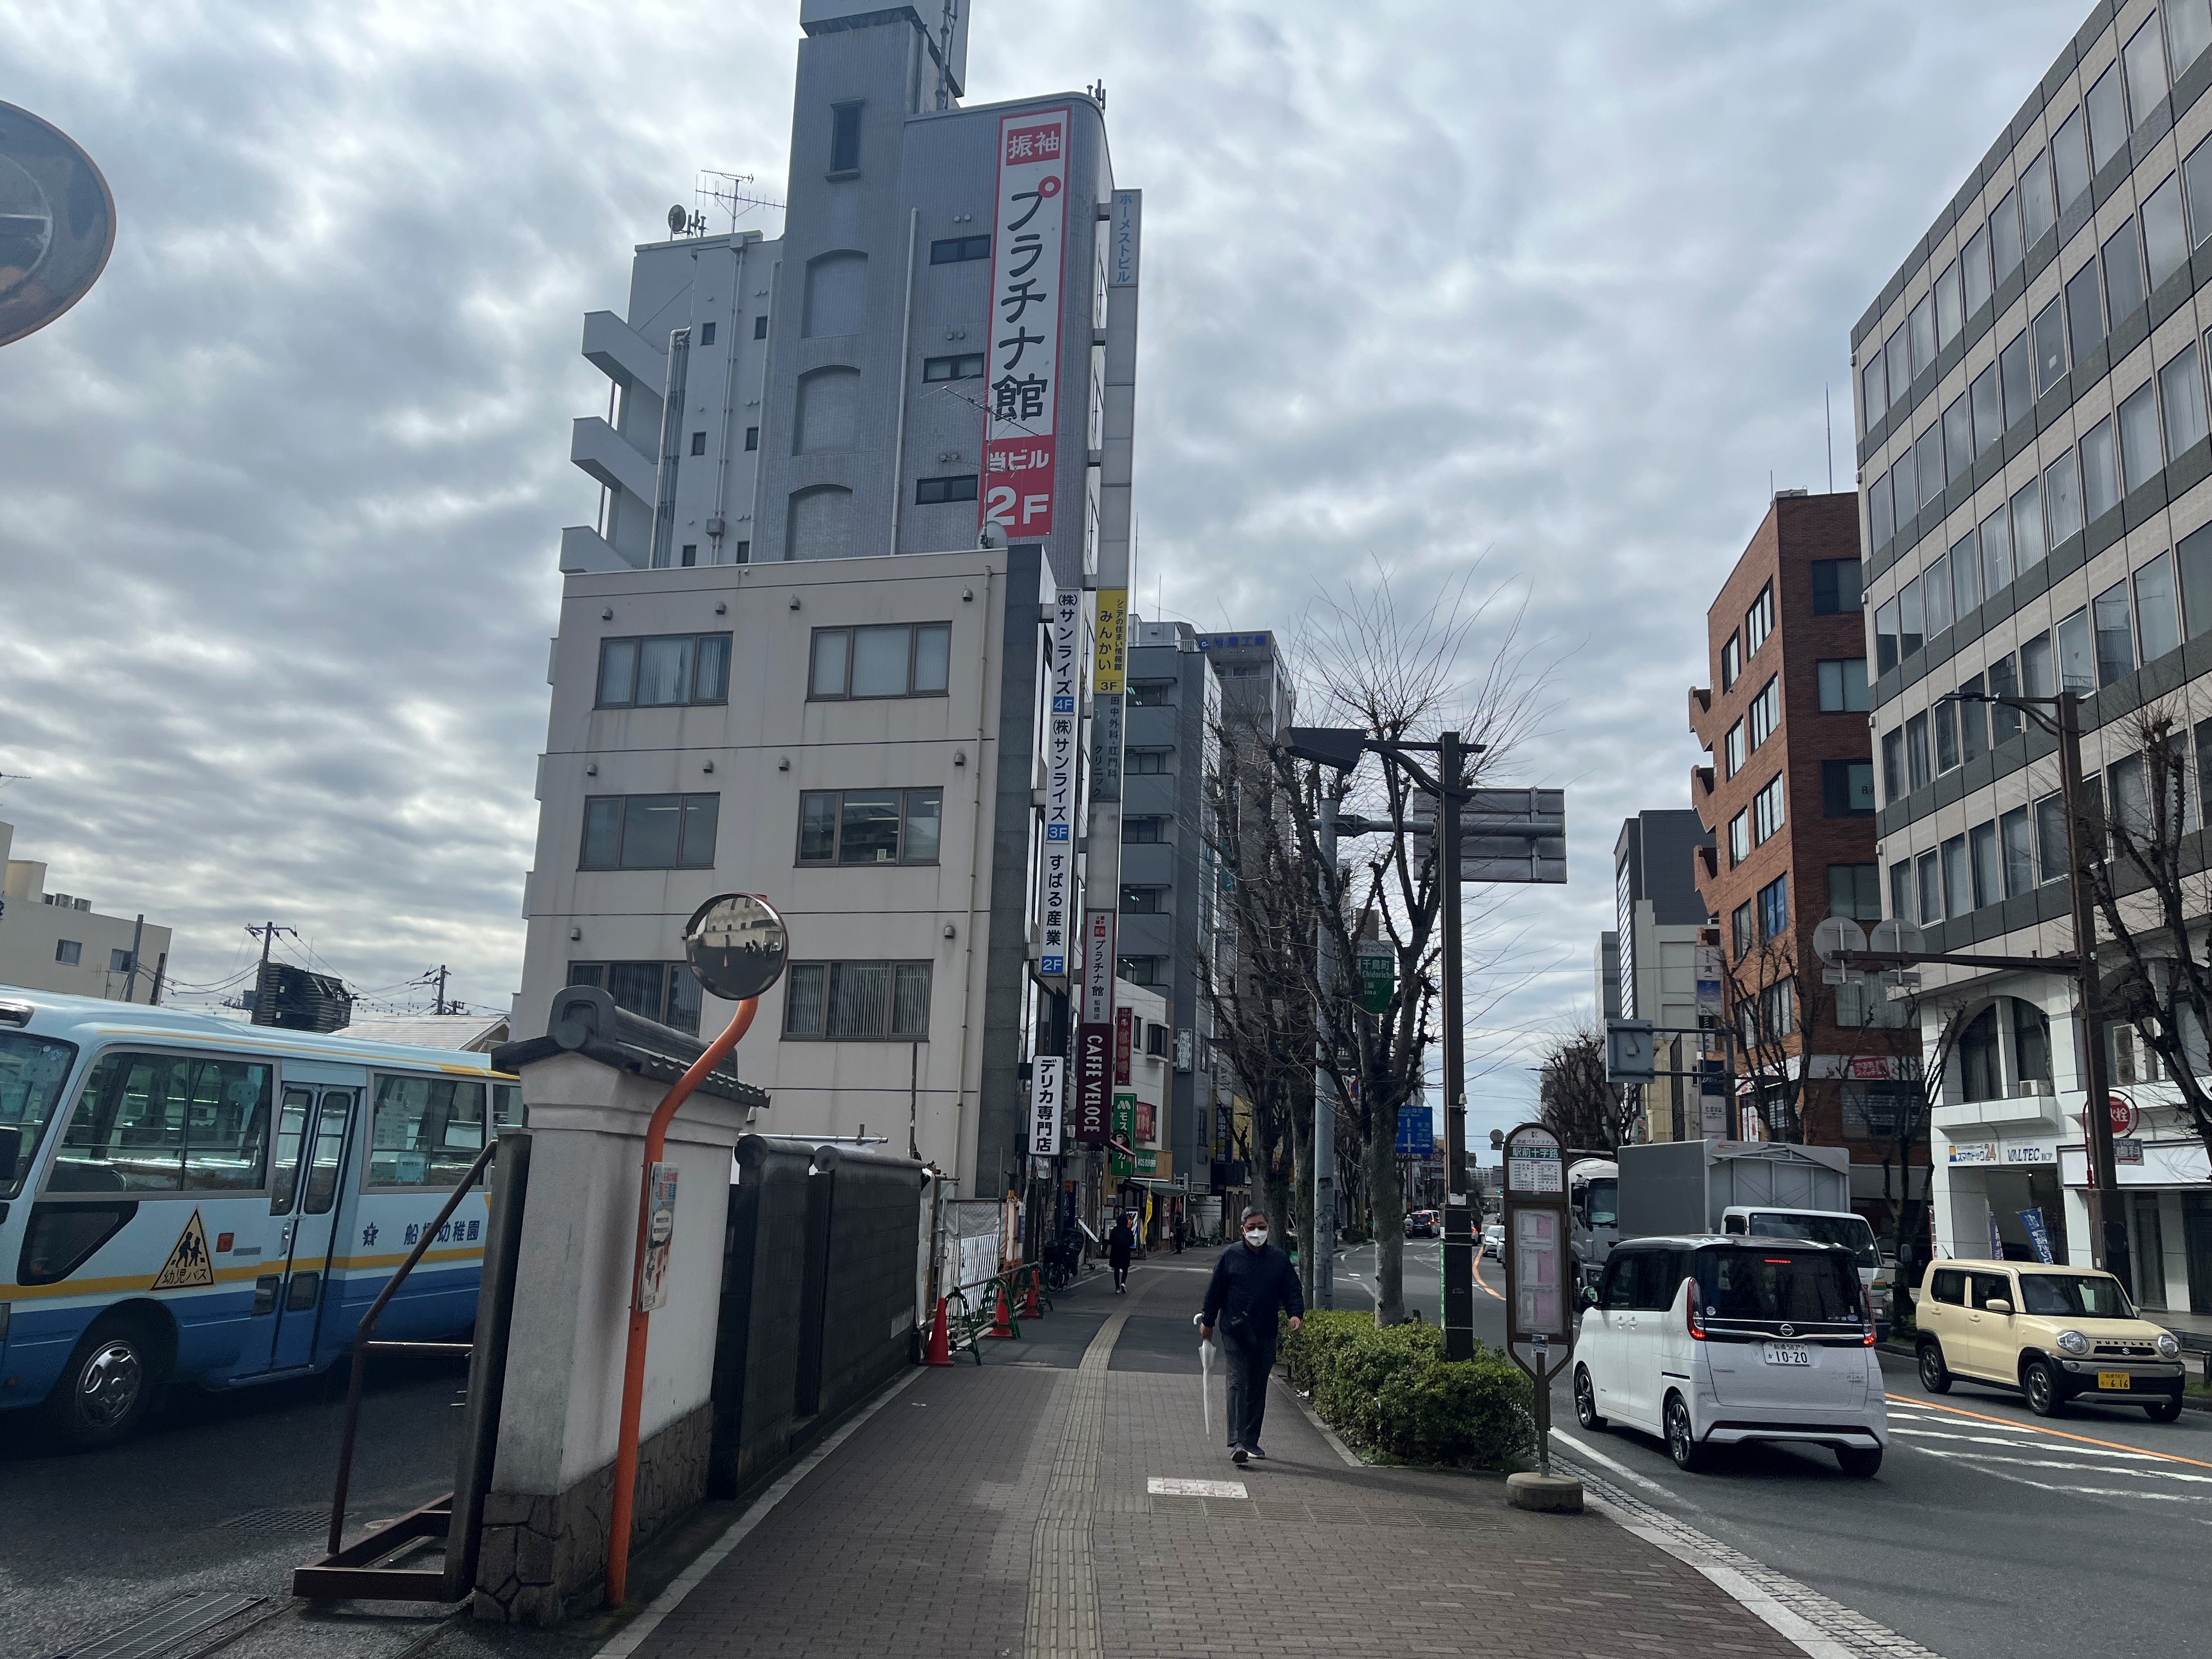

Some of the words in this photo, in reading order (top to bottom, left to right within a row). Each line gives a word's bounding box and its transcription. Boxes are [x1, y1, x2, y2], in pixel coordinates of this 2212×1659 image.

[1008, 131, 1060, 159] 振袖
[1116, 194, 1132, 283] ホーメストビル
[992, 176, 1061, 422] プラチナ館
[990, 449, 1049, 471] 当ビル
[985, 486, 1049, 526] 2F
[1098, 611, 1113, 670] みんかい
[1101, 682, 1118, 690] 3F
[1054, 699, 1073, 710] 4F
[1093, 745, 1103, 795] クリニック
[1048, 827, 1068, 838] 3F
[1046, 854, 1064, 946] すばる産業
[1043, 959, 1062, 970] 2F
[1091, 939, 1106, 996] プラチナ館
[1362, 959, 1390, 970] 千鳥町
[1035, 1058, 1057, 1152] デリカ専門店
[1084, 1081, 1102, 1132] VELOCE
[1513, 1147, 1558, 1158] 駅前十字路
[2008, 1148, 2040, 1161] VALTEC
[404, 1220, 480, 1245] 船幼稚園
[162, 1268, 207, 1284] 幼児バス
